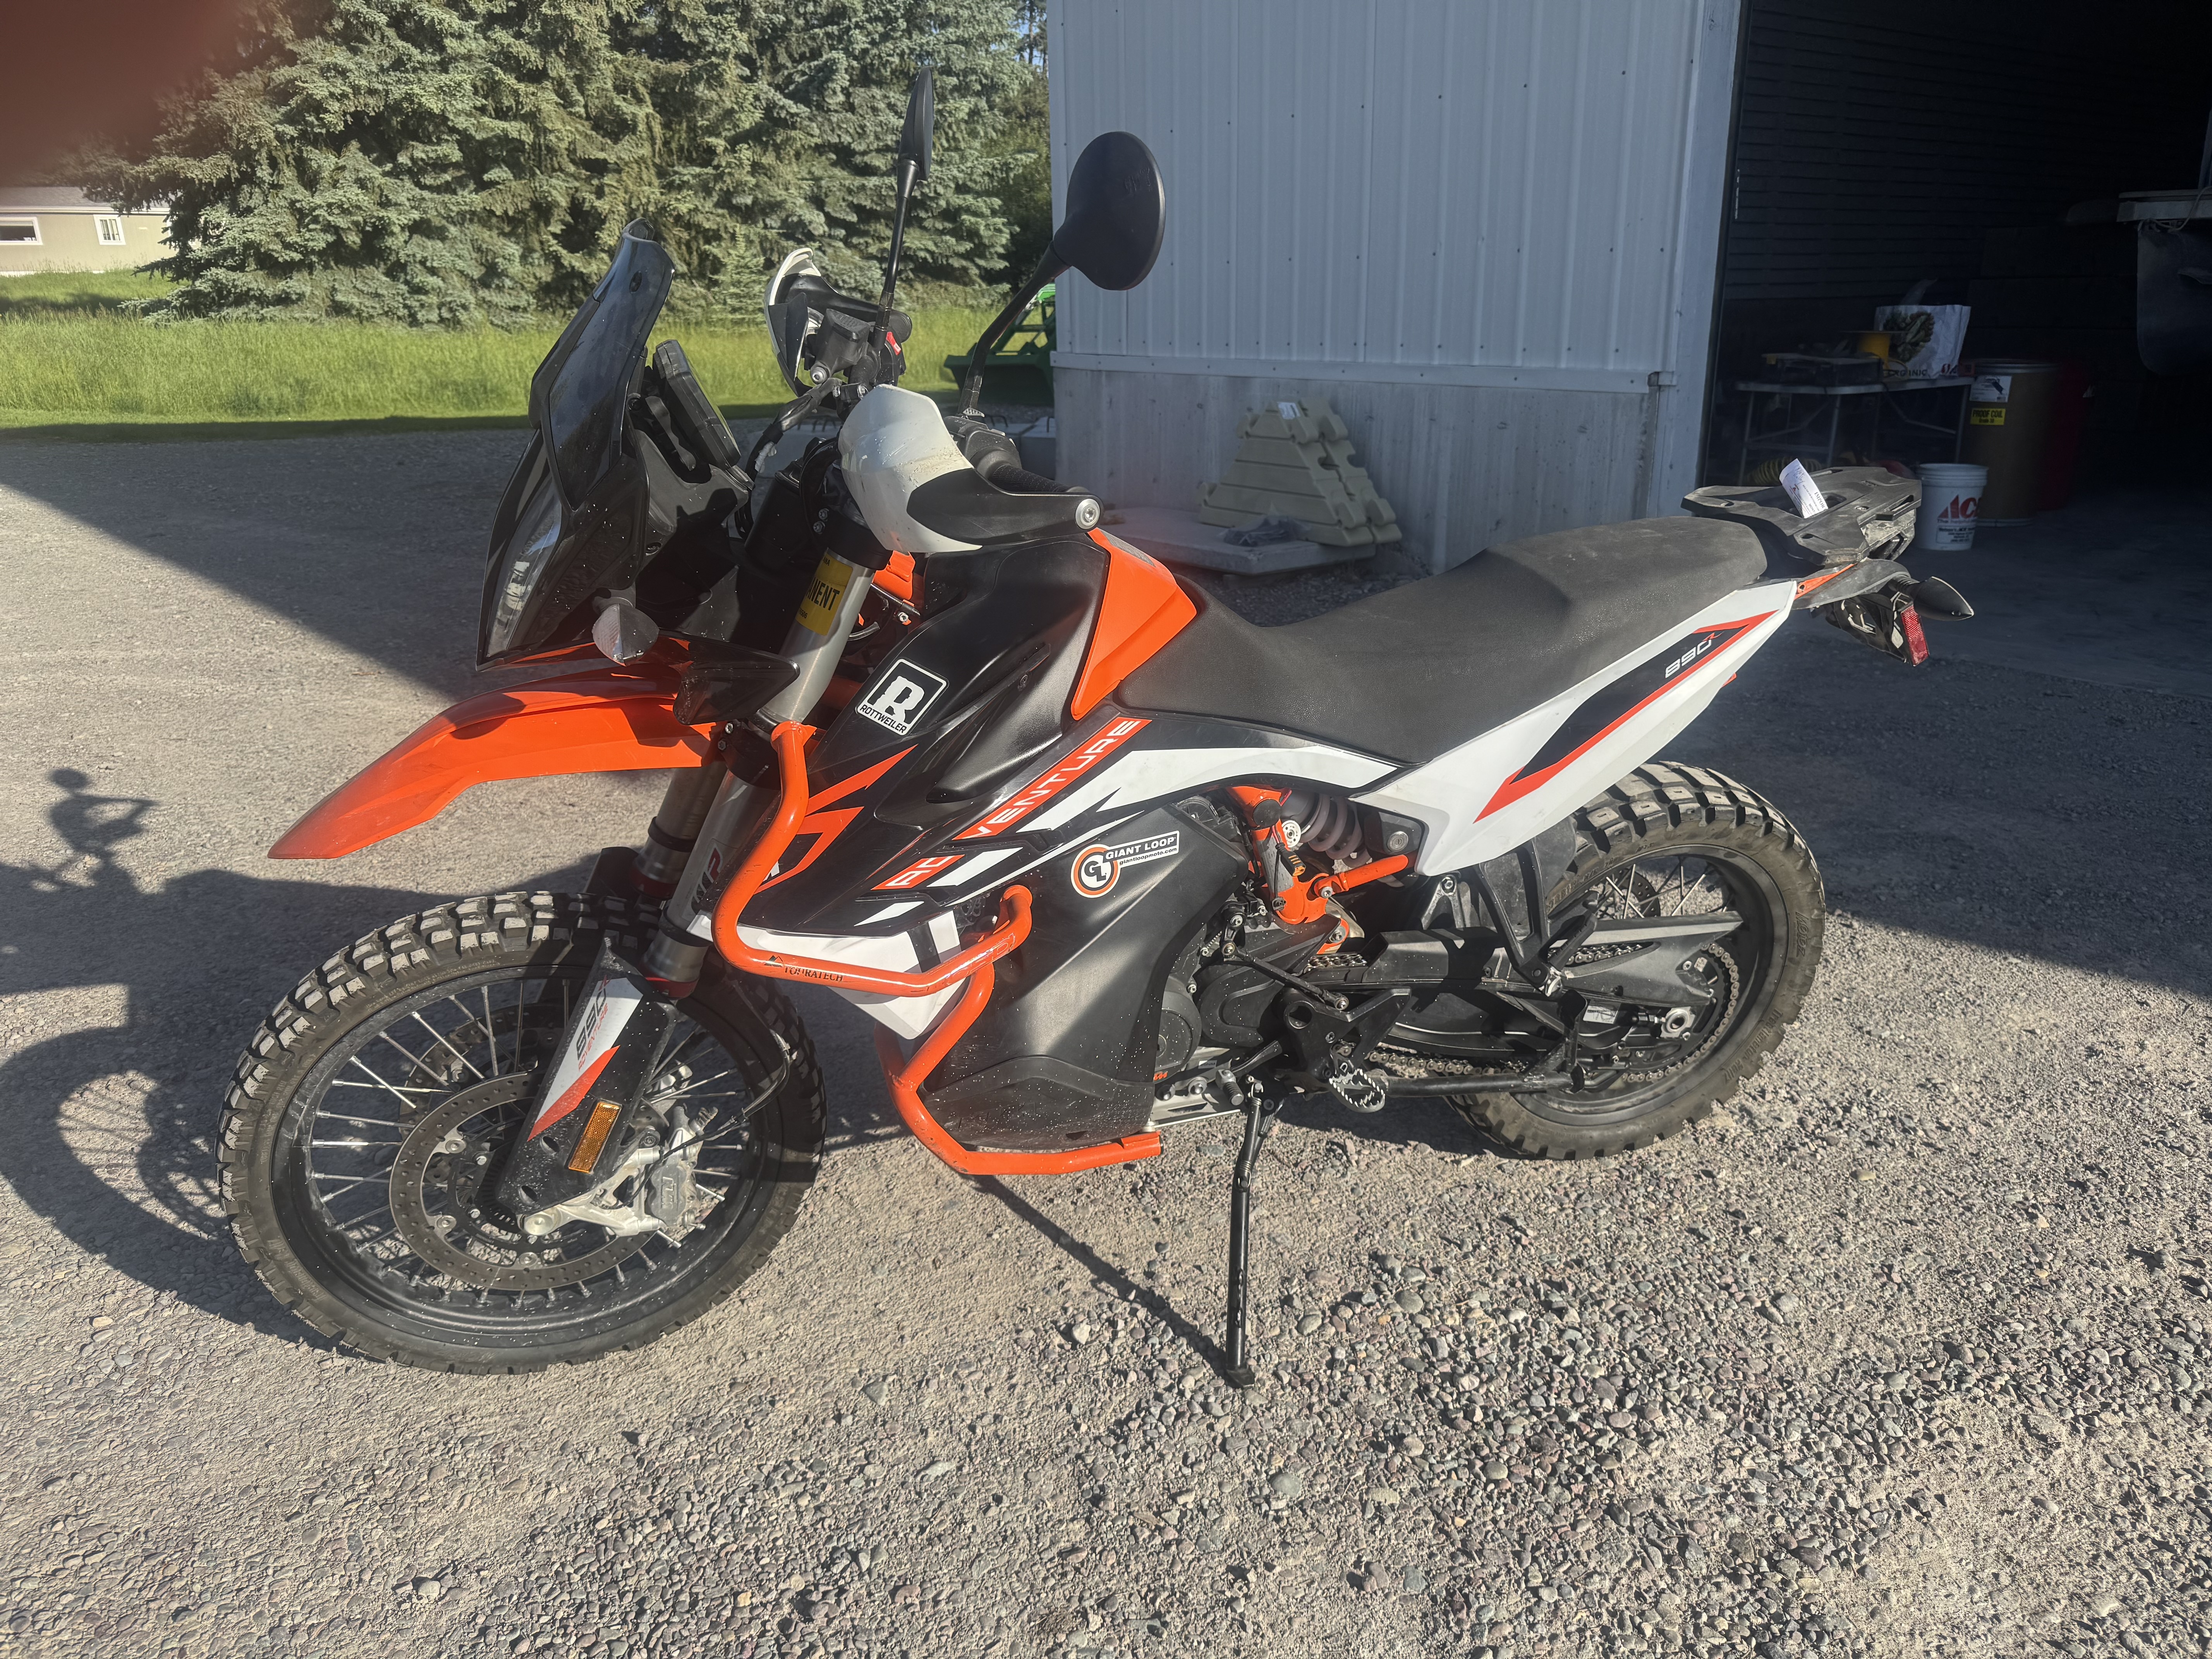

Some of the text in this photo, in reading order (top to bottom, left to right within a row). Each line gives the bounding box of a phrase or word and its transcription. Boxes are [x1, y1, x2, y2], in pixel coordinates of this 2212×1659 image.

[873, 675, 925, 724] R
[860, 704, 907, 733] ROTTWEILER
[1105, 836, 1175, 860] GIANT LOOP
[1119, 848, 1177, 866] giantloopmoto.com
[578, 1002, 608, 1072] ADVENTURE
